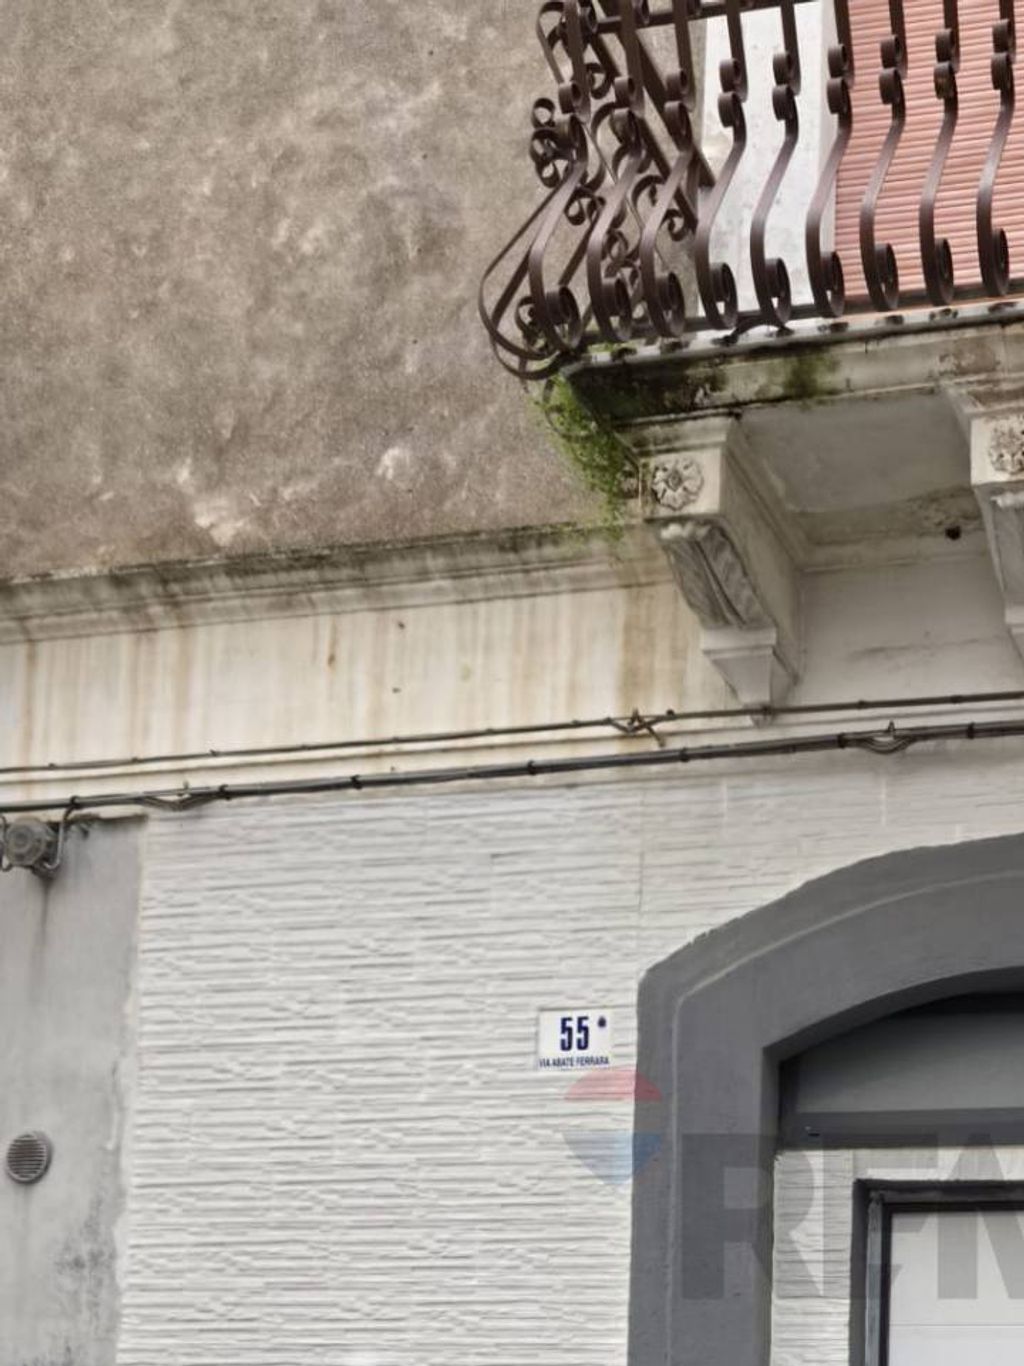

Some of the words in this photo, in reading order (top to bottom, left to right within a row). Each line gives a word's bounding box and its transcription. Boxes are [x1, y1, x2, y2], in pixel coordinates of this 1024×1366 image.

[560, 1016, 589, 1051] 55
[539, 1058, 550, 1068] VIA
[552, 1057, 574, 1067] ABATE
[576, 1056, 610, 1066] FERRARA
